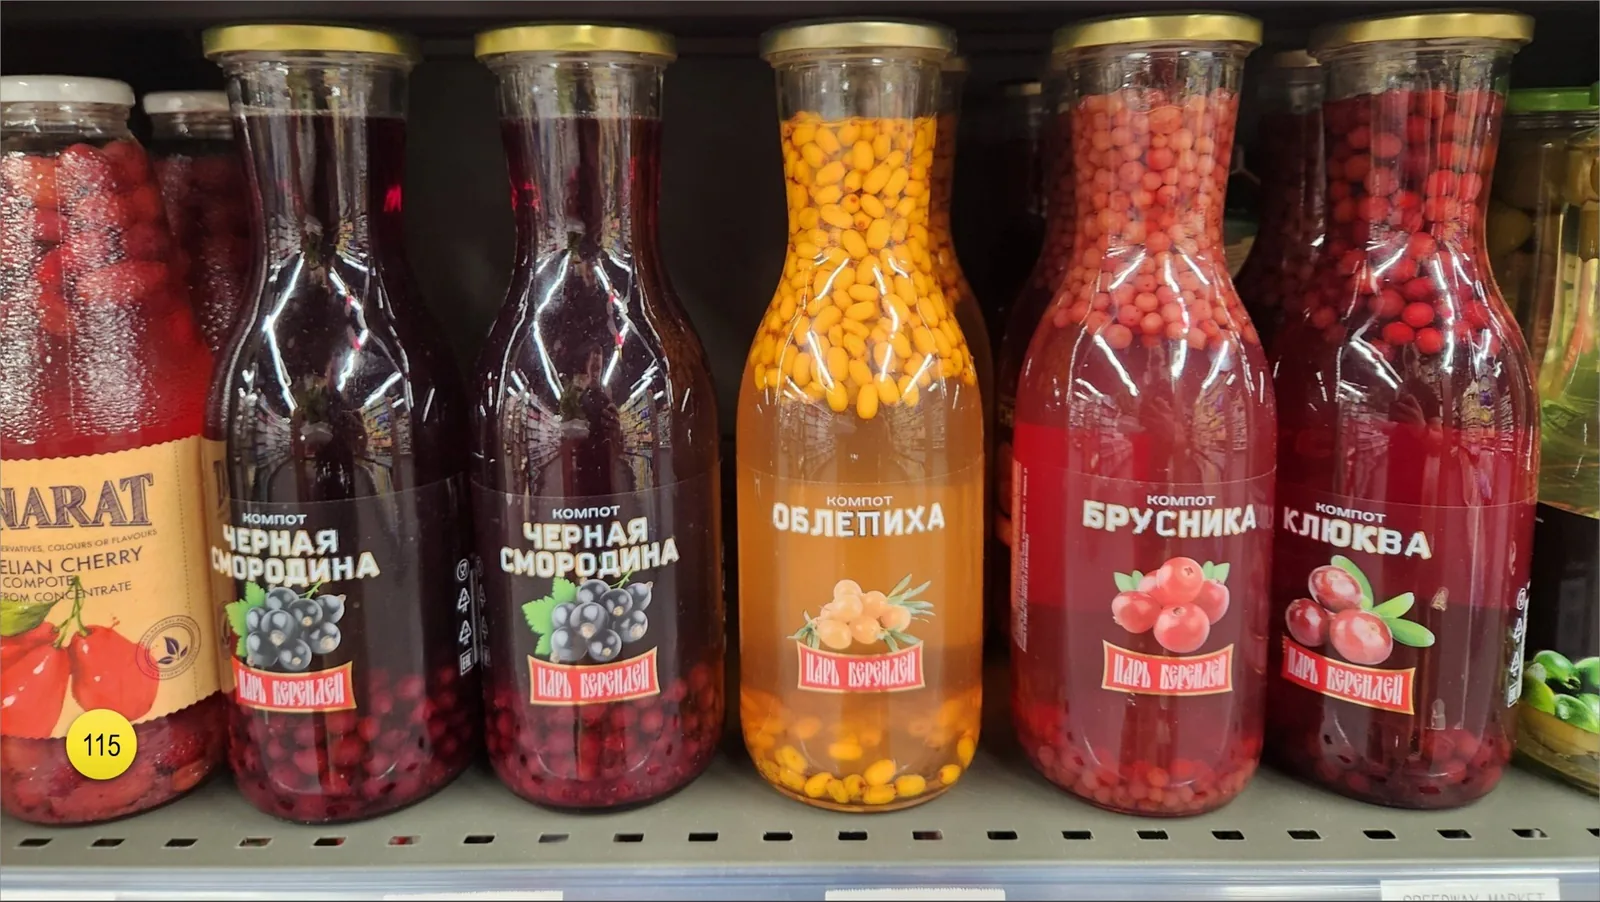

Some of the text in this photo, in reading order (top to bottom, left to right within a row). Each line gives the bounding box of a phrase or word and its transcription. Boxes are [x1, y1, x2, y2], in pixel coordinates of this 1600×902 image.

[552, 505, 620, 520] КОМПОТ
[826, 495, 893, 507] КОМПОТ
[1146, 495, 1216, 506] КОМПОТ
[1315, 502, 1387, 523] КОМПОТ
[242, 512, 307, 525] КОМПОТ
[522, 517, 648, 550] ЧЕРНАЯ
[772, 502, 945, 537] ОБЛЕПИХА
[1082, 499, 1256, 538] БРУСНИКА
[1283, 506, 1432, 560] КЛЮКВА
[47, 541, 92, 552] COLOURS
[94, 538, 108, 547] OR
[111, 529, 158, 544] FLAVOURS
[223, 524, 339, 556] ЧЕРНАЯ
[61, 546, 143, 573] CHERRY
[211, 545, 380, 587] СМОРОДИНА
[500, 537, 680, 579] СМОРОДИНА
[3, 575, 75, 589] COMPOTE
[34, 581, 132, 602] CONCENTRATE
[538, 659, 650, 699] ЦАРЬ БЕРЕНДЕЙ
[806, 651, 915, 688] ЦАРЬ БЕРЕНДЕЙ
[1113, 653, 1226, 690] ЦАРЬ БЕРЕНДЕЙ
[1287, 646, 1403, 705] ЦАРЬ БЕРЕНДЕЙ
[238, 670, 345, 706] ЦАРЬ БЕРЕНДЕЙ
